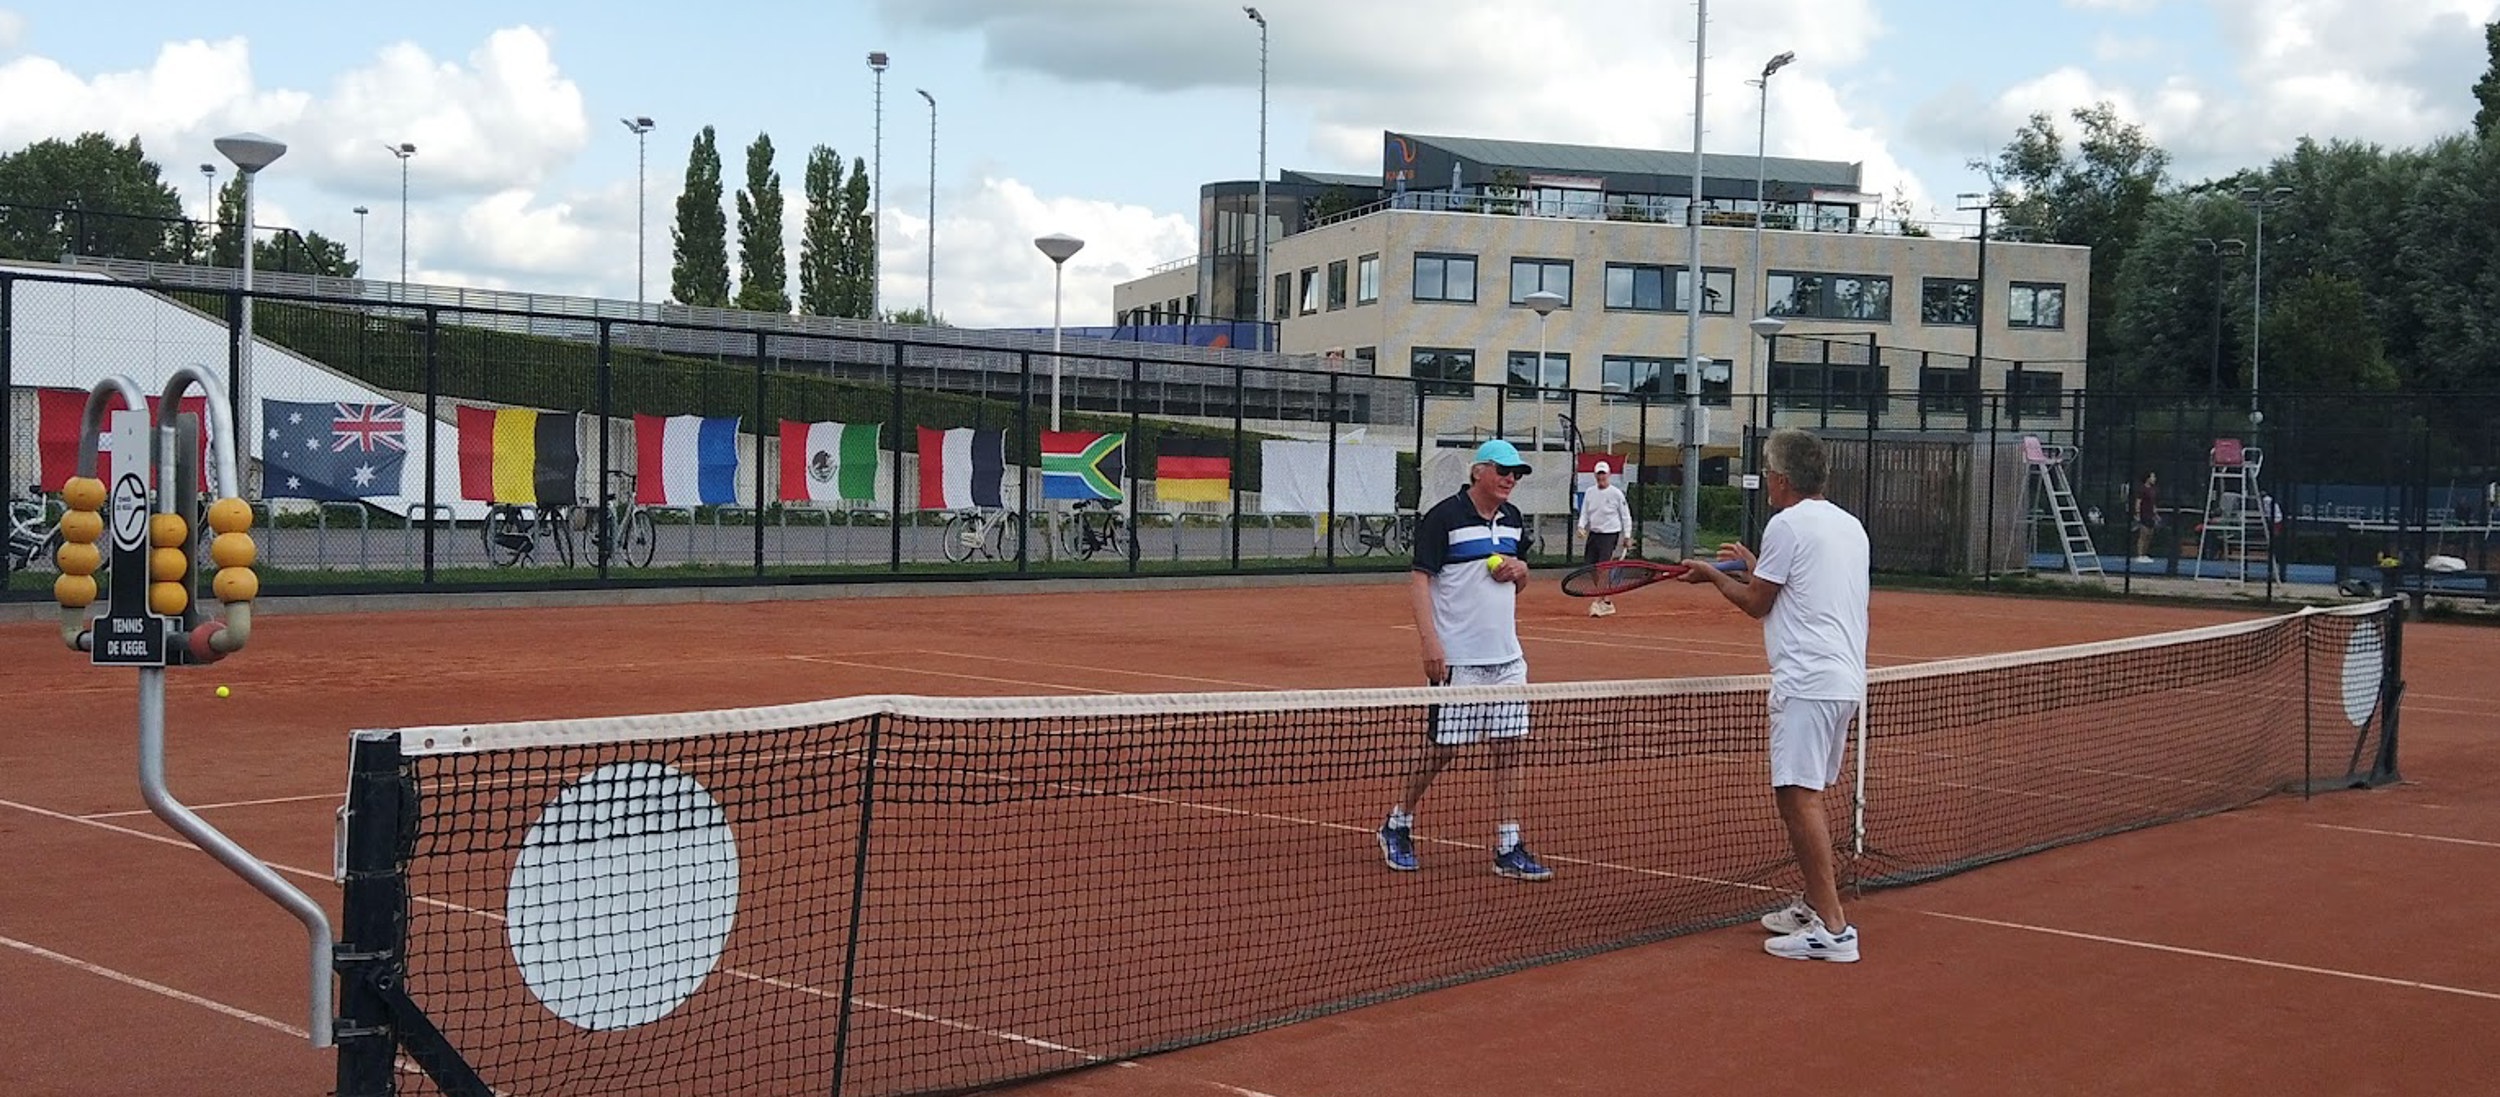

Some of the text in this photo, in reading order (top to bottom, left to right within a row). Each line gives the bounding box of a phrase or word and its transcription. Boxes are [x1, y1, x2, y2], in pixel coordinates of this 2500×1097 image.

[112, 617, 145, 634] TENNIS
[107, 640, 149, 656] DE KEGEL
